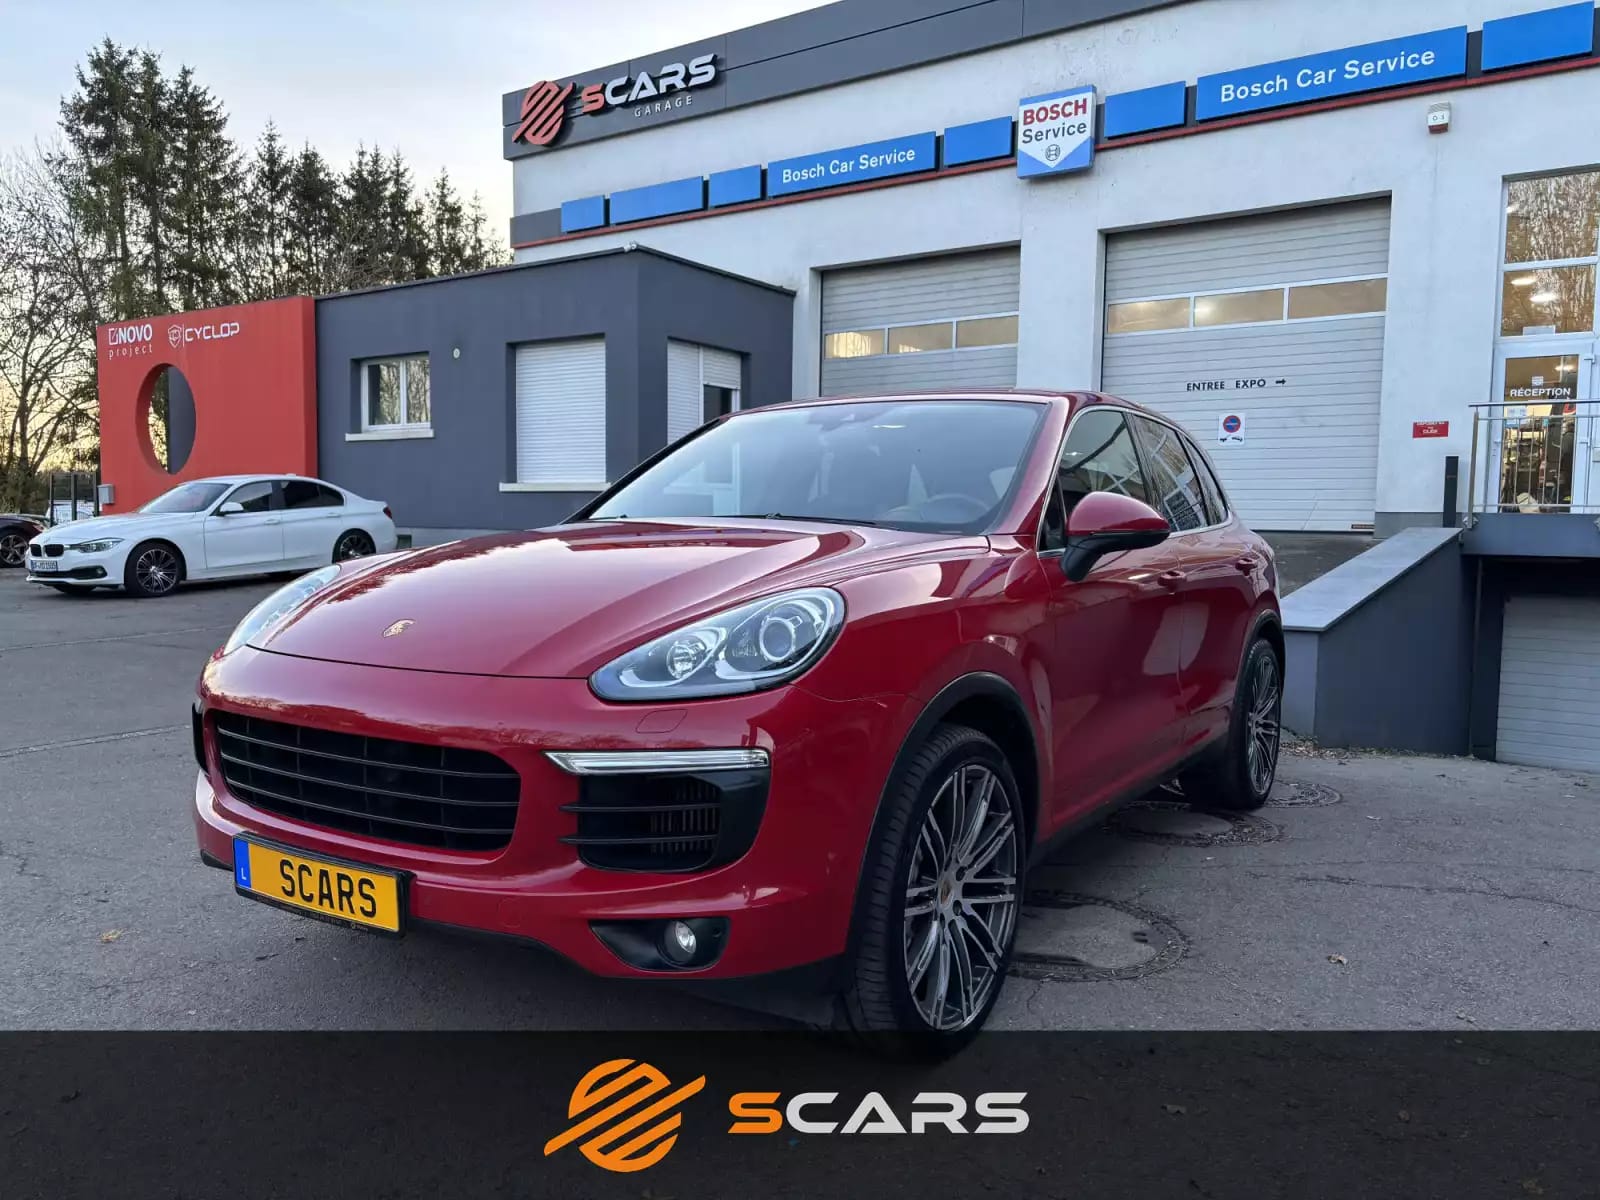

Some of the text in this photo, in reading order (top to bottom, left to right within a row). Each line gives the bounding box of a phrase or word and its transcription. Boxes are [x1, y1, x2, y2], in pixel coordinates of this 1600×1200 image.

[581, 53, 718, 113] SCARS
[1220, 50, 1435, 102] Bosch Car Service
[634, 95, 693, 117] GARAGE
[1023, 98, 1087, 126] BOSCH
[1021, 121, 1087, 144] Service
[782, 148, 916, 184] Bosch Car Service
[184, 322, 240, 343] CYCLOP
[108, 344, 153, 361] project
[1186, 379, 1266, 392] ENTREE EXPO
[1510, 387, 1571, 397] RÉCEPTION
[240, 867, 247, 881] L
[279, 859, 377, 918] SCARS
